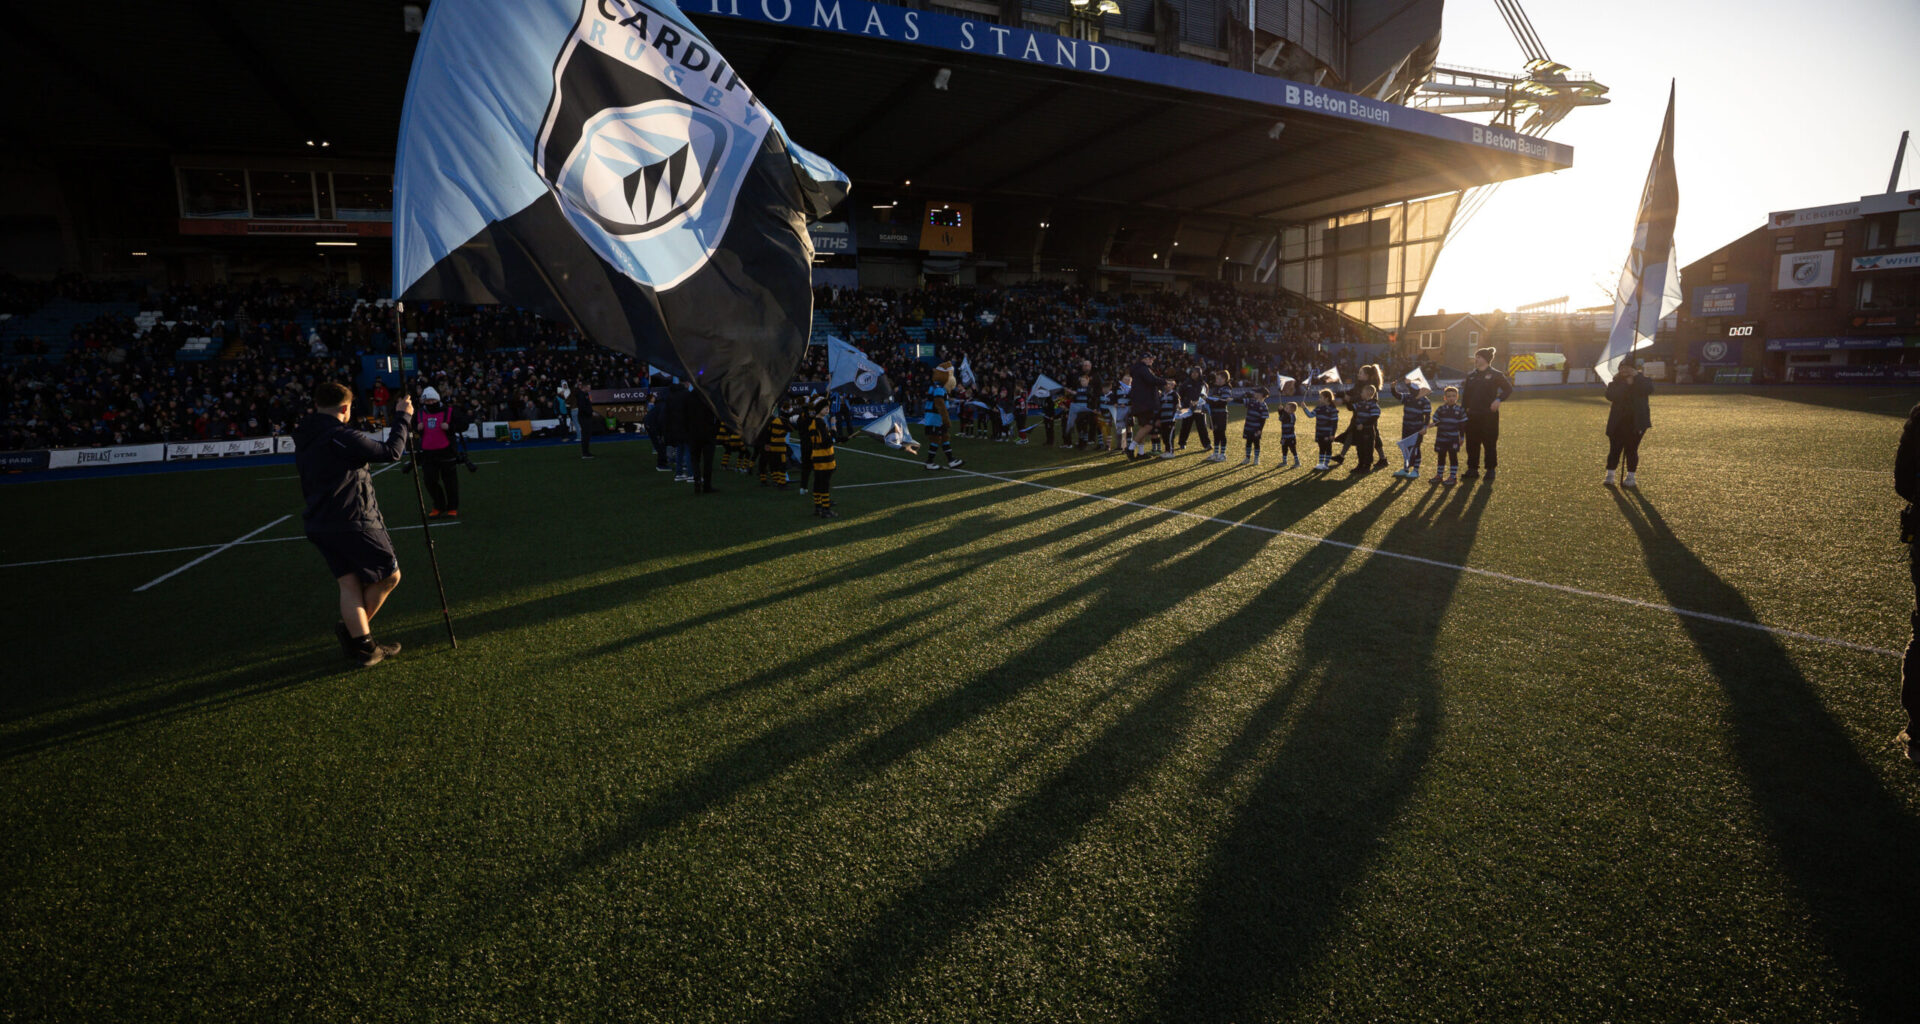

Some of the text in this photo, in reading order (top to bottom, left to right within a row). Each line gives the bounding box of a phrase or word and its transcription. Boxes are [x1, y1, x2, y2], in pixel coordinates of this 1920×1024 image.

[960, 22, 1111, 73] STAND
[589, 19, 761, 126] RUGBY
[1303, 89, 1347, 114] Beton
[1349, 99, 1390, 123] Bauen
[1485, 130, 1517, 151] Beton
[1518, 138, 1548, 158] Bauen
[1728, 326, 1753, 337] 0:00
[77, 450, 112, 464] EVERLAST
